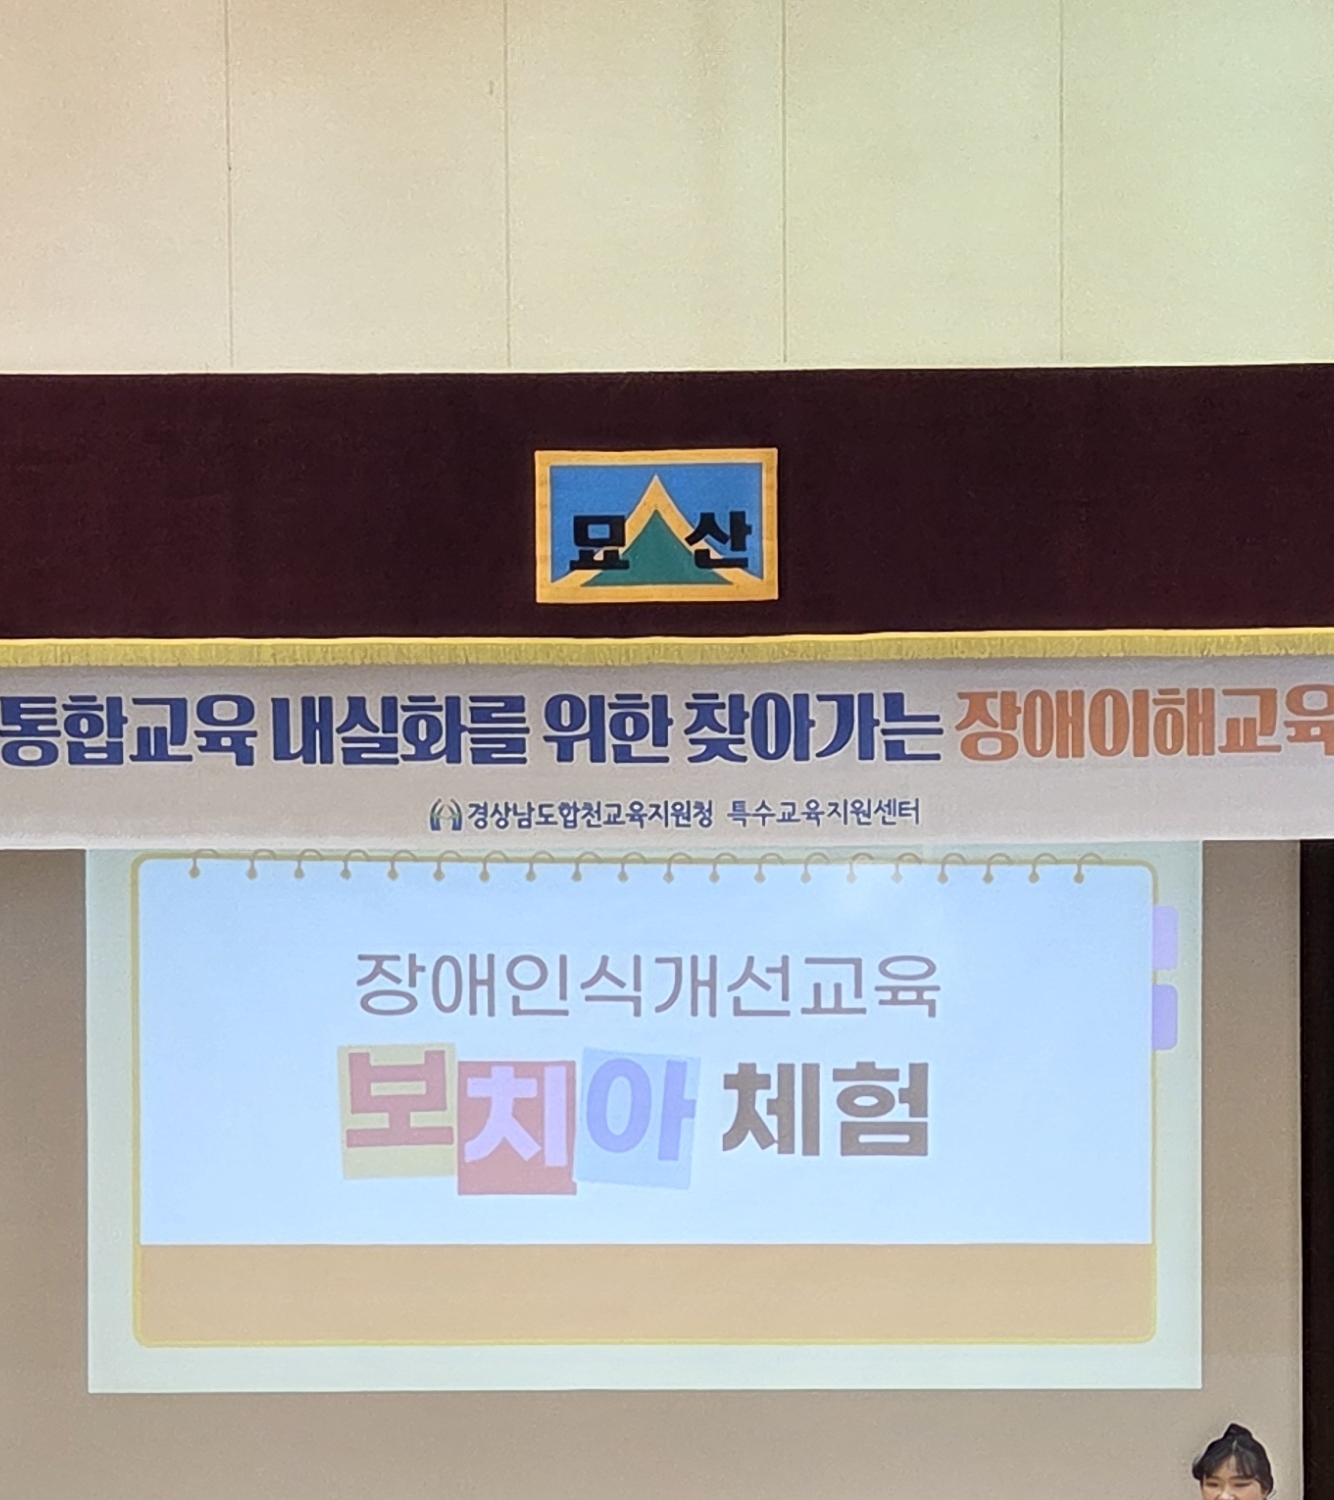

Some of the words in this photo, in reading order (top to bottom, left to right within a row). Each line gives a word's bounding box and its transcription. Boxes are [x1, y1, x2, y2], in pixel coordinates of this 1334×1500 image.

[272, 693, 531, 766] 내실화를
[542, 692, 672, 766] 위한
[685, 690, 943, 764] 찾아가는
[468, 799, 714, 829] 경상남도합천교육지원청
[728, 798, 921, 827] 특수교육지원센터
[356, 953, 942, 1019] 장애인식개선교육
[345, 1048, 697, 1167] 보치아
[722, 1060, 930, 1157] 체험
